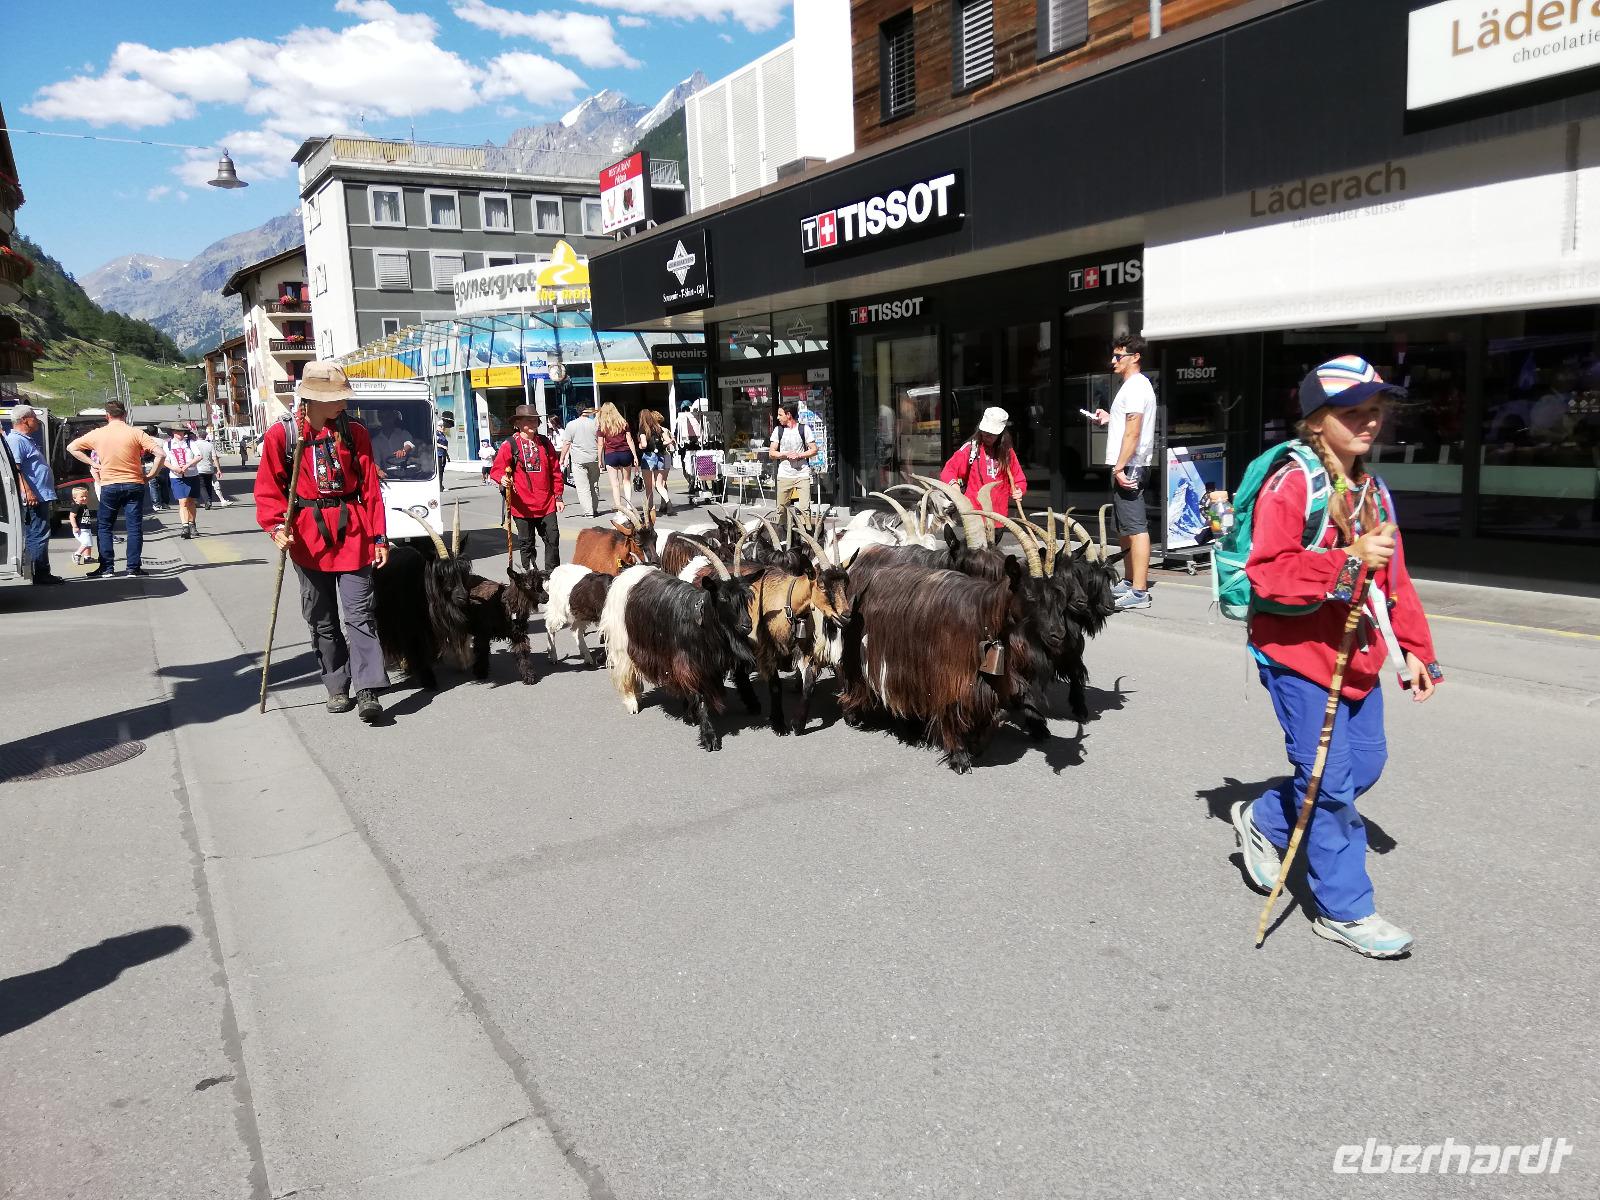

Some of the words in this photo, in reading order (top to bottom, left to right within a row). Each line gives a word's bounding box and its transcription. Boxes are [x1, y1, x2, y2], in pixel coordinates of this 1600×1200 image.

[1250, 161, 1406, 217] Läderach
[837, 173, 956, 242] TISSOT
[454, 269, 536, 301] gornergrat
[1100, 259, 1143, 286] TIS
[868, 296, 924, 322] TISSOT
[656, 348, 708, 359] souvenirs
[1176, 366, 1217, 379] TISSOT
[364, 382, 387, 390] Firefly
[1203, 451, 1224, 460] TISSOT
